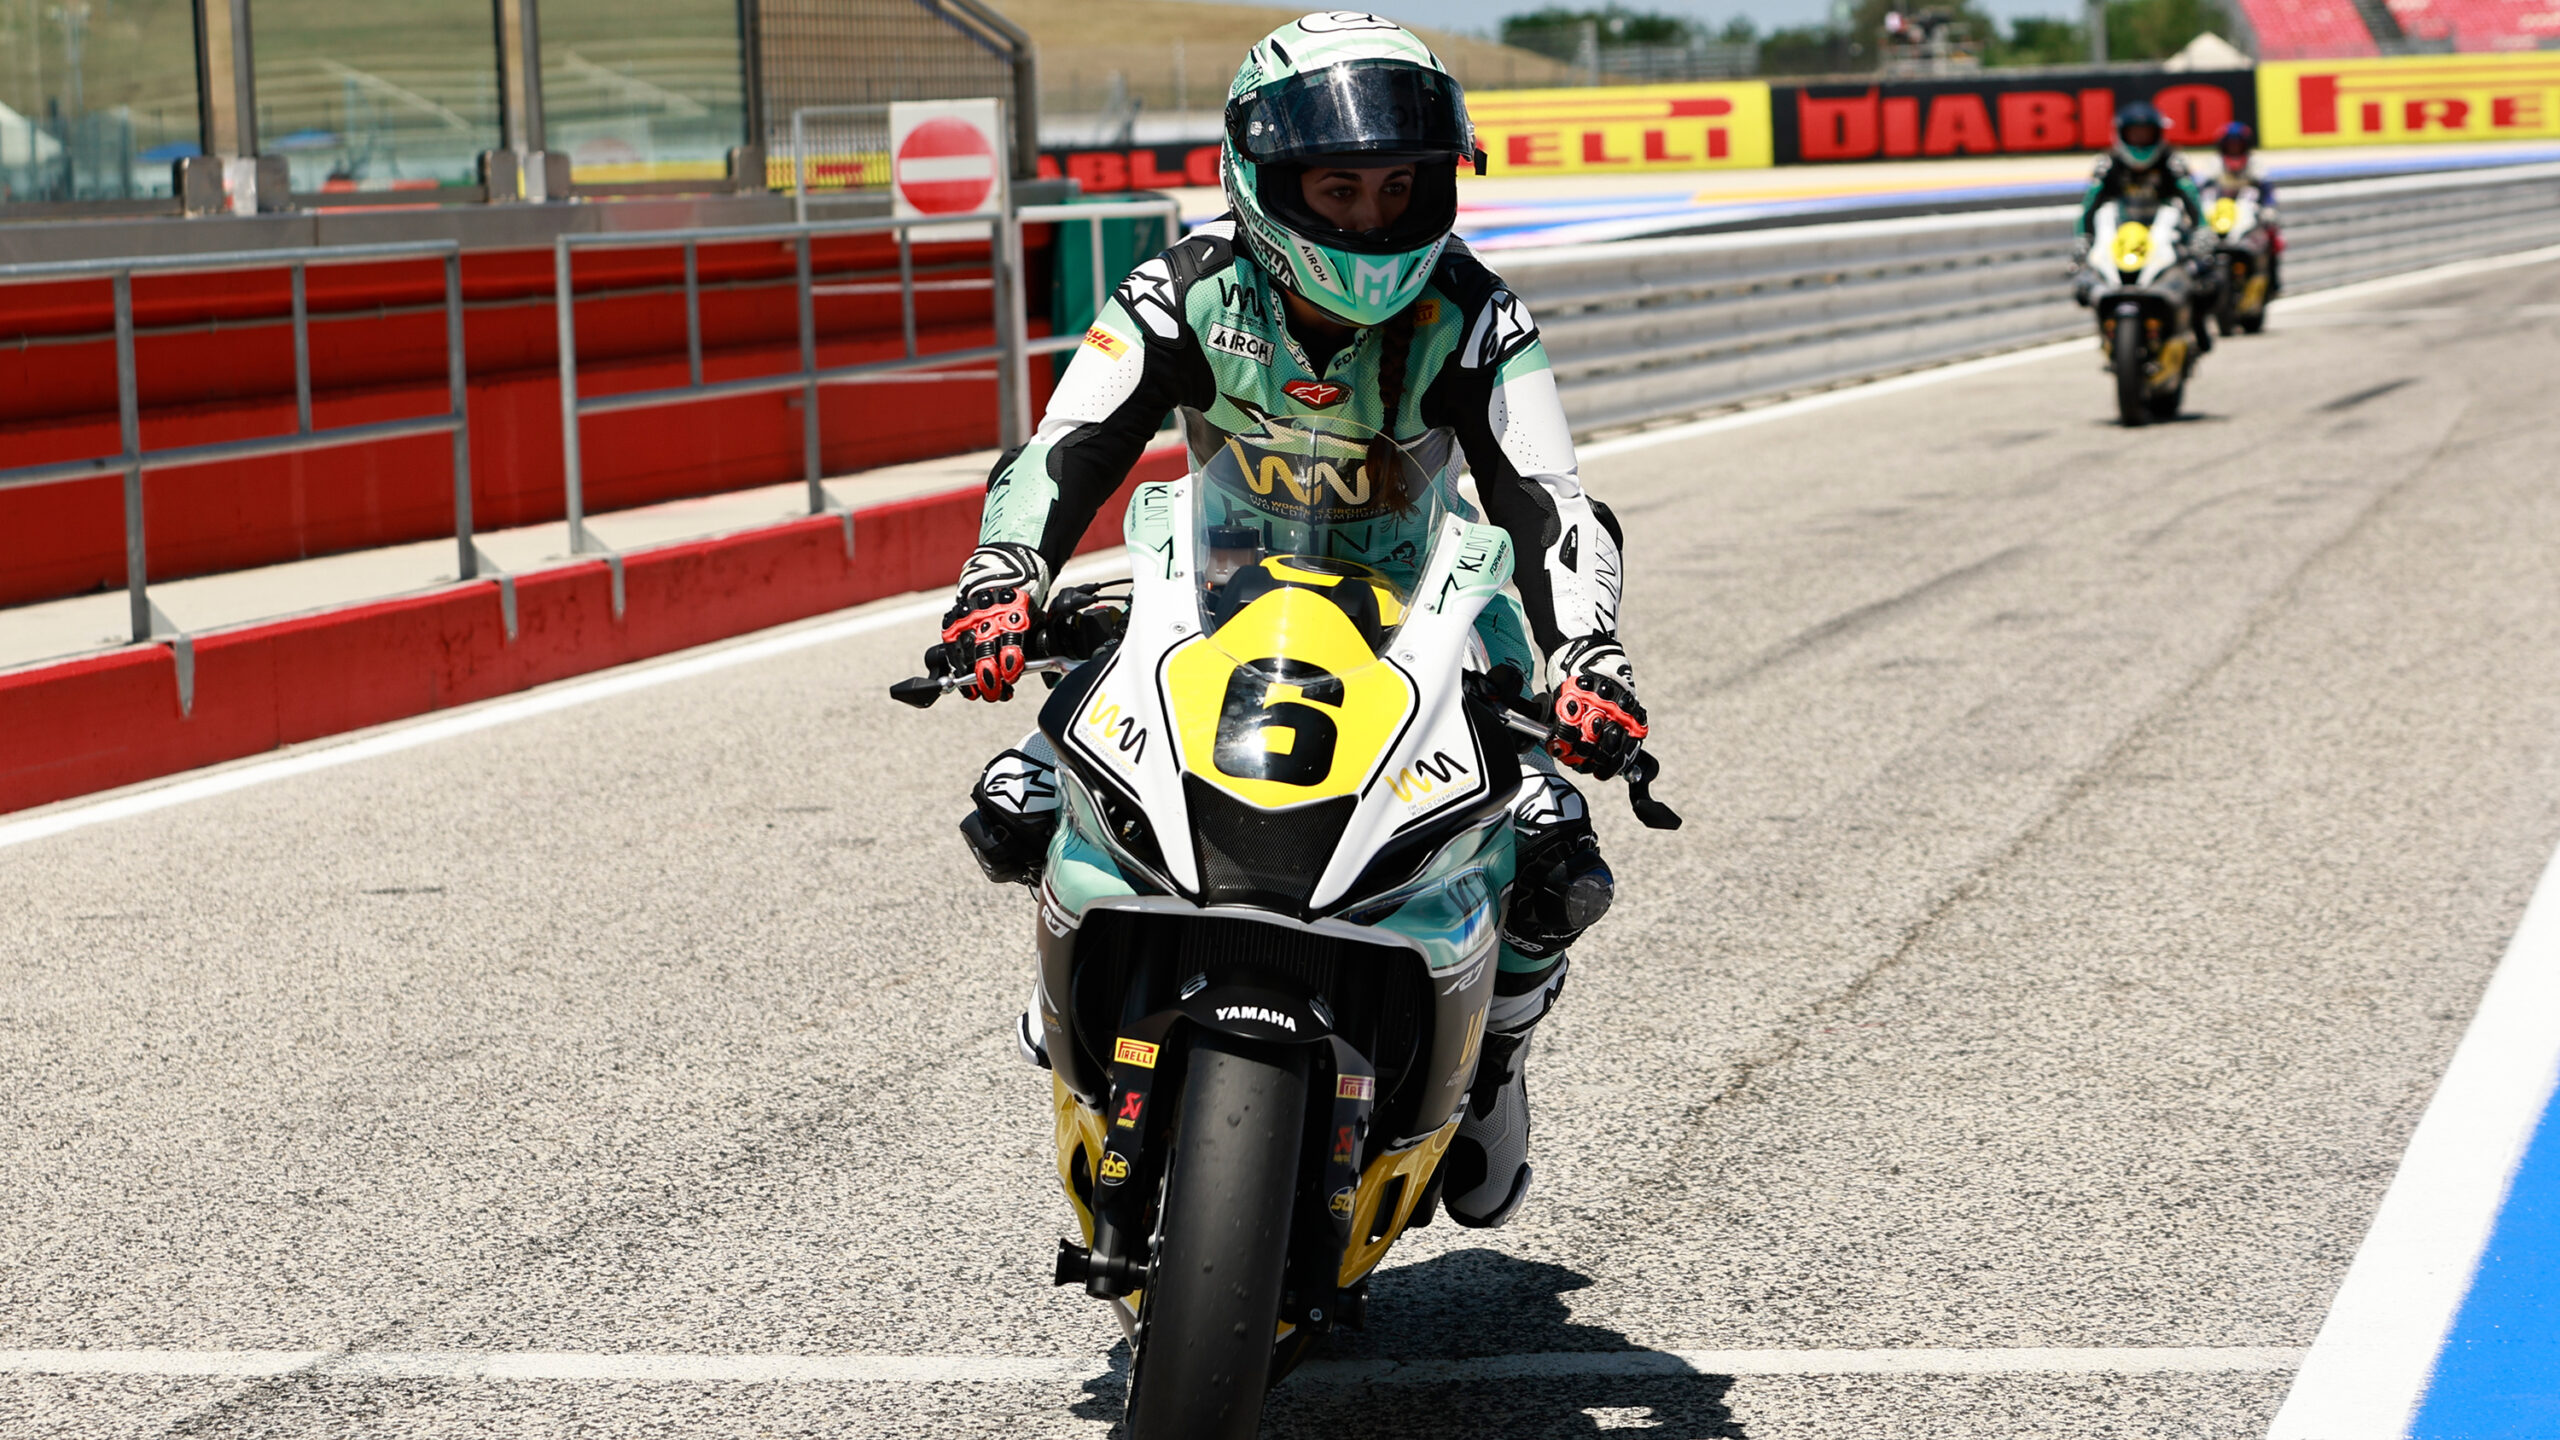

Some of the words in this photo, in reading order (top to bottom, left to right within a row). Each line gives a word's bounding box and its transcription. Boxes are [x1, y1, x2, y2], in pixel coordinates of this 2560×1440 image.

[1239, 91, 1257, 105] AIROH
[1797, 84, 2233, 161] DIABLO
[1301, 245, 1328, 282] AIROH
[1418, 240, 1441, 278] AIROH
[1213, 330, 1269, 361] AIROH
[1144, 485, 1170, 530] KLINT
[1457, 526, 1493, 573] KLINT
[1213, 657, 1345, 787] 6
[1215, 1006, 1297, 1032] YAMAHA
[1118, 1041, 1154, 1064] PIRELLI
